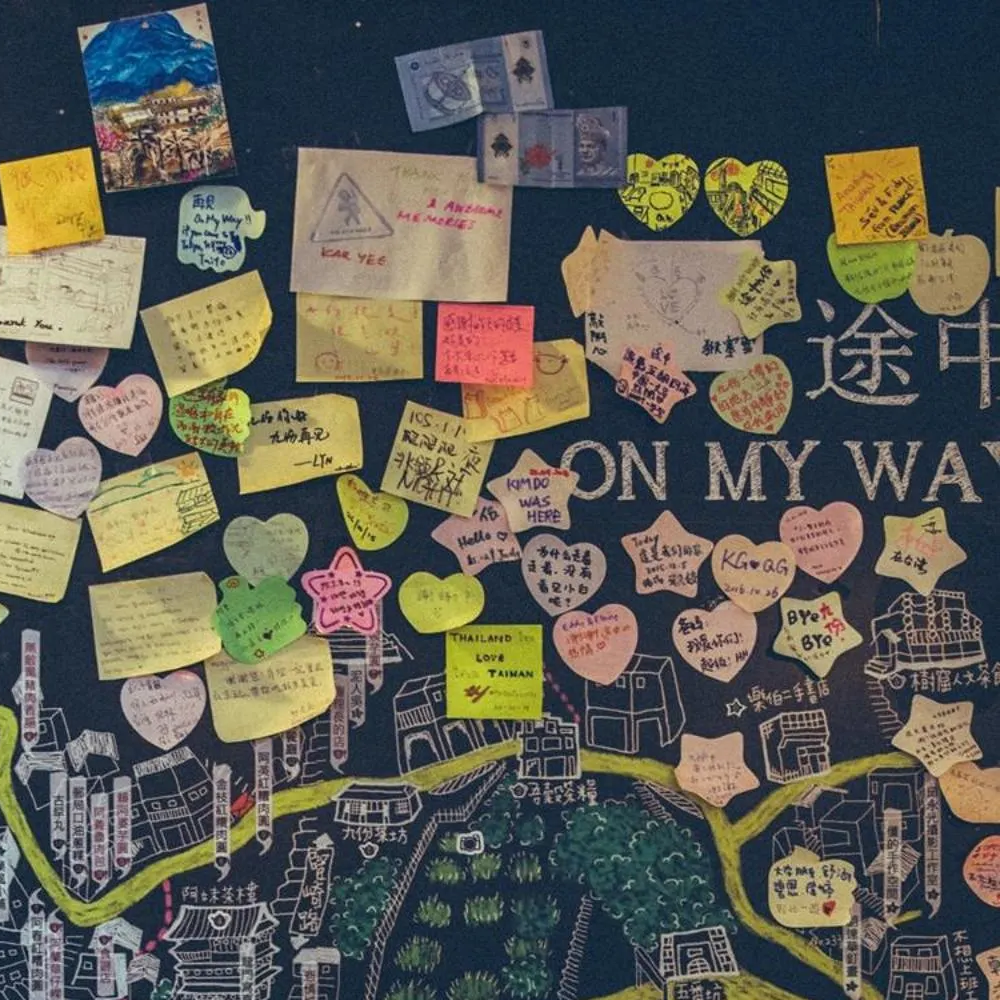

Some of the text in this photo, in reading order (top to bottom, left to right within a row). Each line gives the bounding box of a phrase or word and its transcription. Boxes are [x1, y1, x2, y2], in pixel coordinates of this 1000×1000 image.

[560, 440, 670, 501] ON
[704, 439, 821, 501] MY
[527, 510, 562, 523] HERE
[451, 631, 512, 644] THAILAND
[488, 668, 534, 679] TAIWAN
